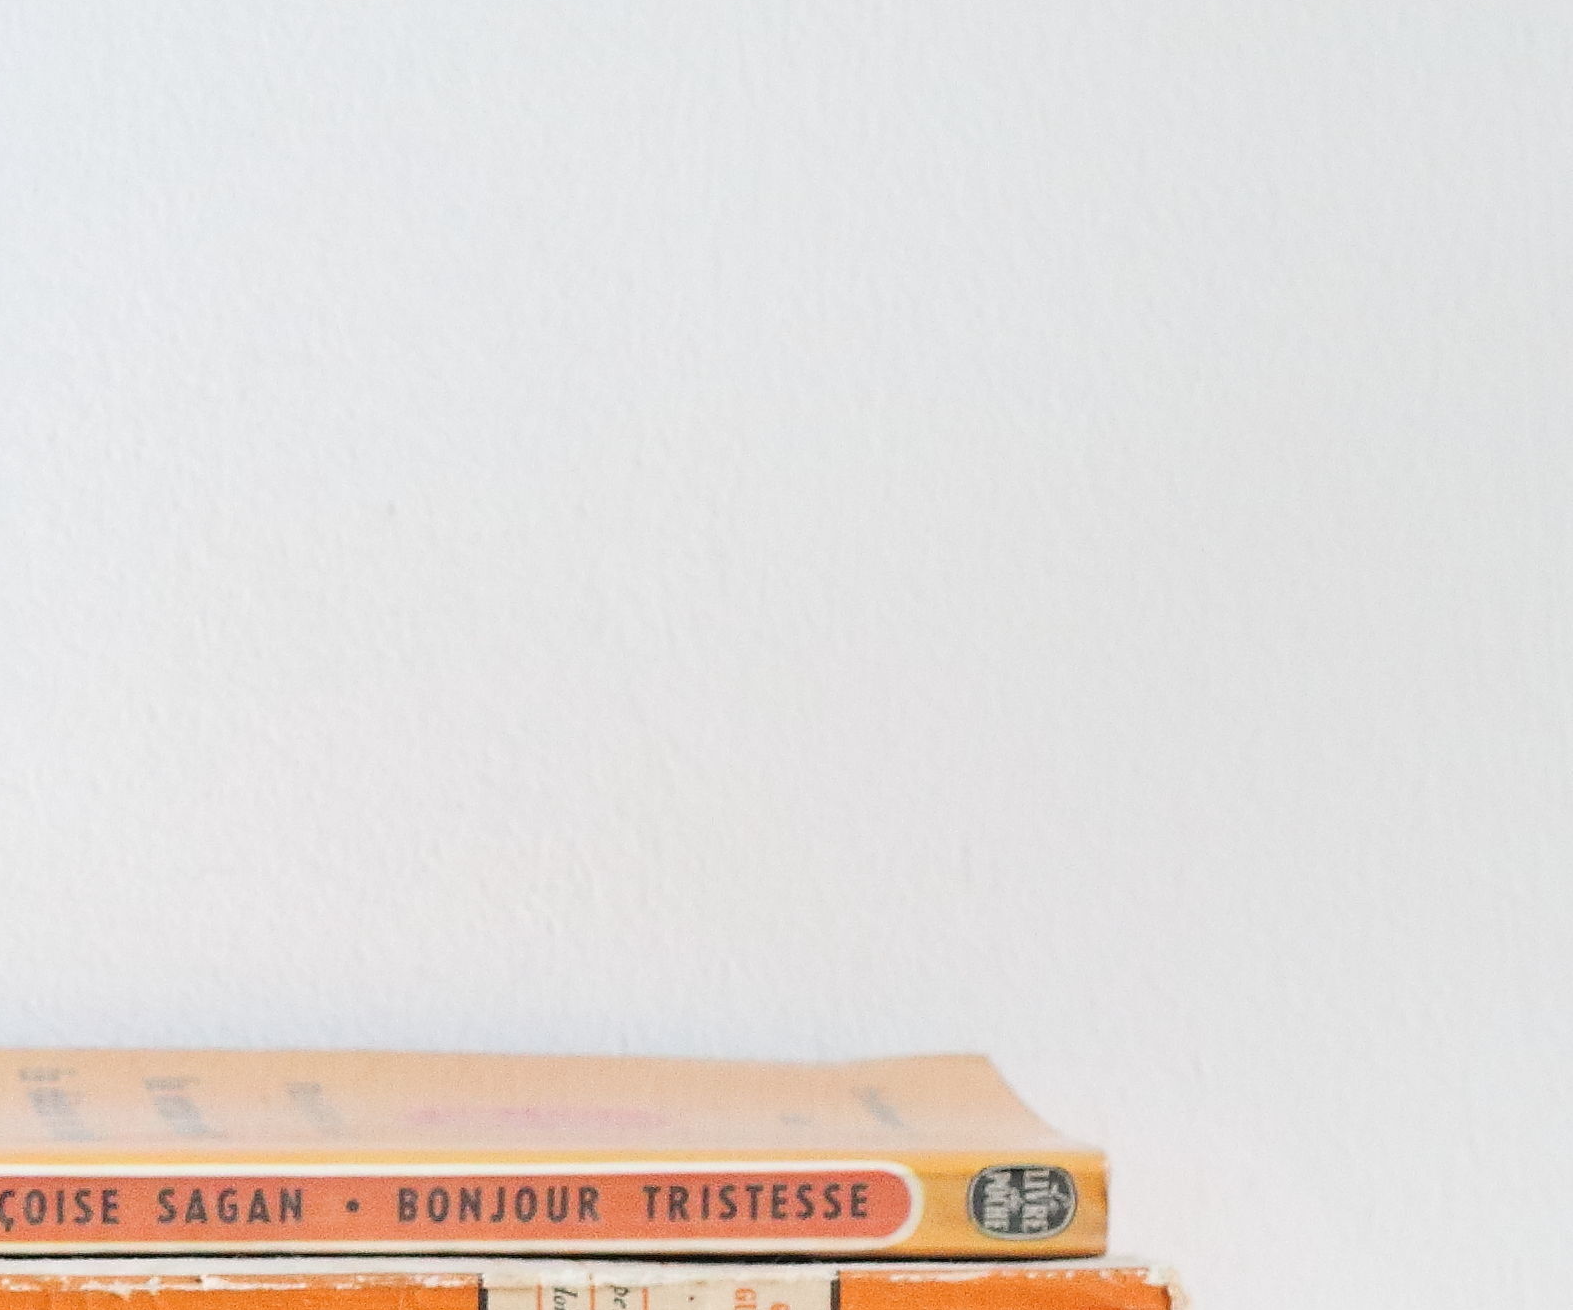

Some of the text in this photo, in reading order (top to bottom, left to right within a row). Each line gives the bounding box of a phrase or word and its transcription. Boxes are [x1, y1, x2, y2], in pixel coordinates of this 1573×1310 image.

[157, 1186, 304, 1224] SAGAN
[397, 1187, 600, 1223] BONJOUR
[642, 1182, 870, 1223] TRISTESSE
